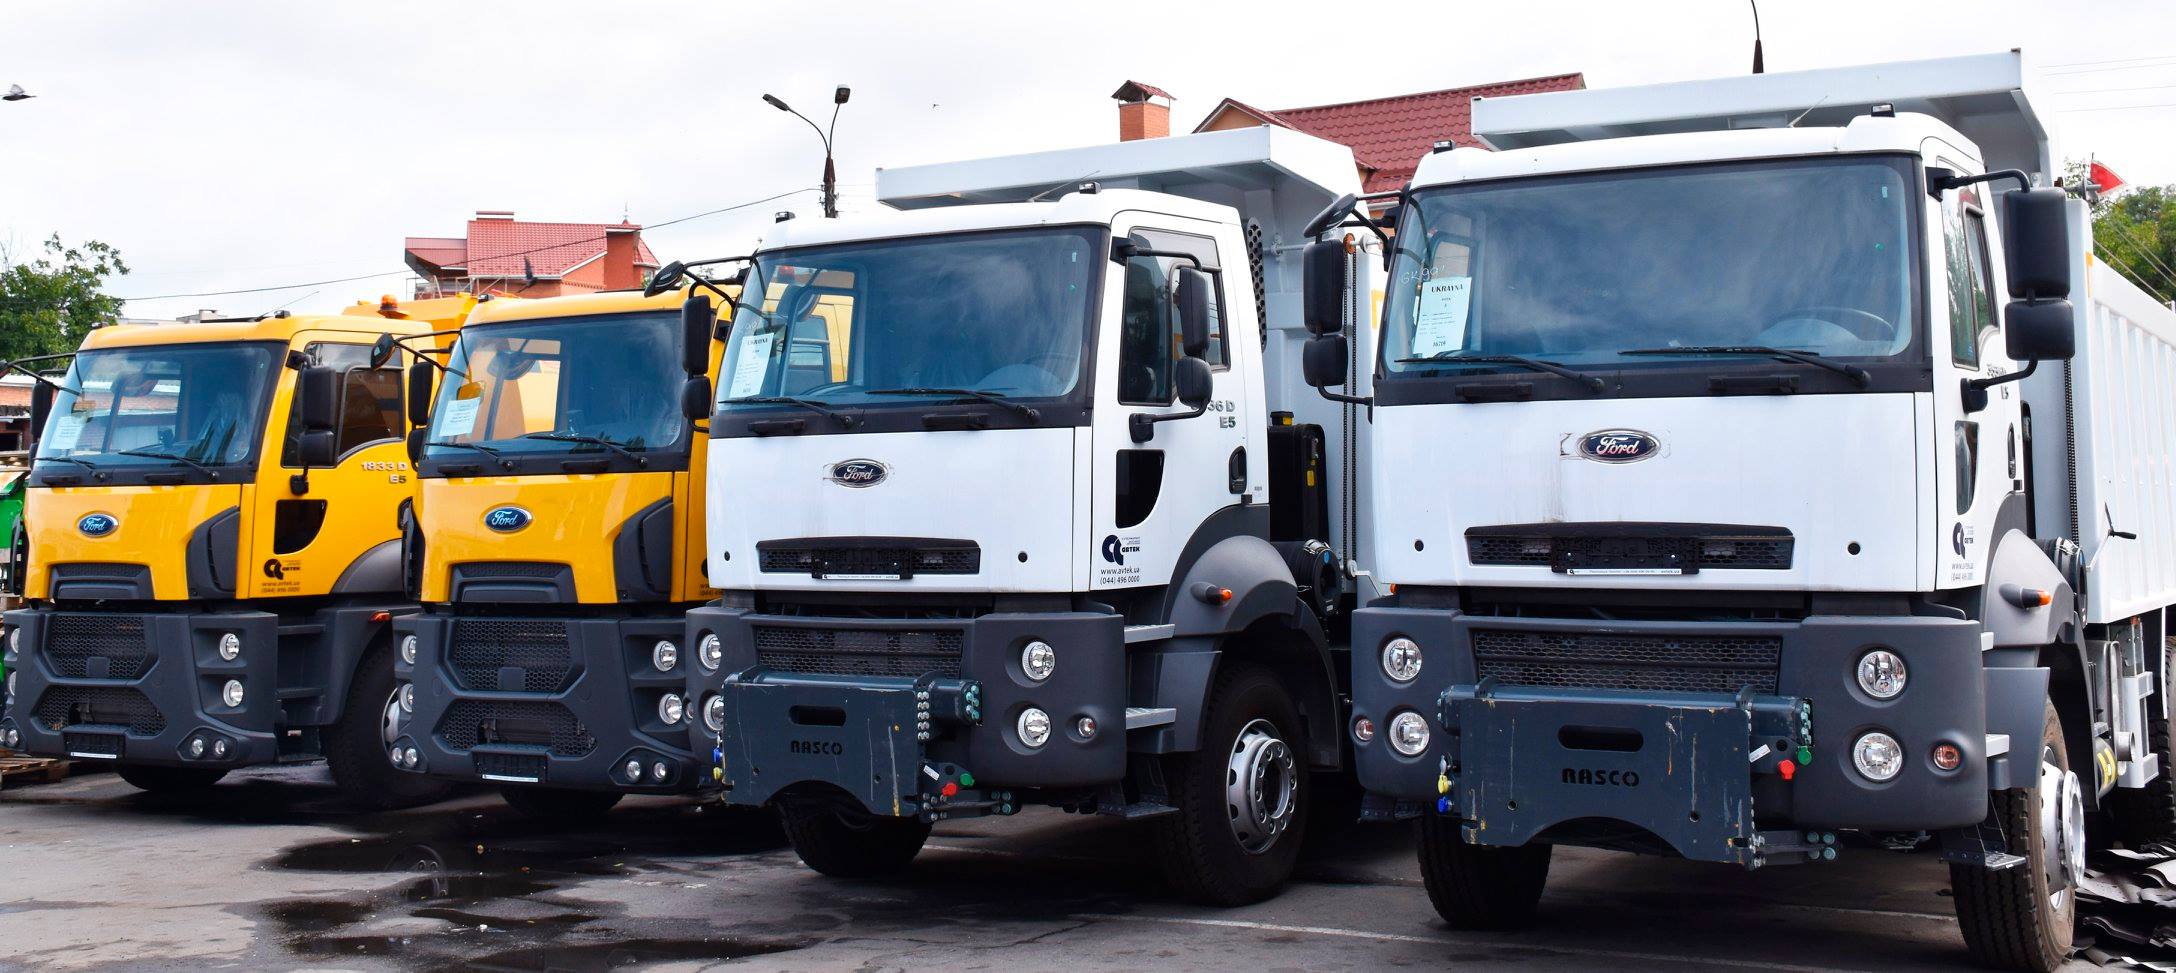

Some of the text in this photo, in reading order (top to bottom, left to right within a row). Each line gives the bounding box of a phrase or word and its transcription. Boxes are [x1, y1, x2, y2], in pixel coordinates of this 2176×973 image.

[1225, 399, 1236, 412] D
[1219, 415, 1237, 429] E5
[1596, 436, 1640, 455] Ford
[361, 461, 408, 472] 1833 D
[843, 465, 874, 480] Ford
[389, 474, 407, 484] E5
[83, 517, 107, 531] Ford
[491, 510, 519, 526] Ford
[1100, 566, 1140, 576] www.avtek.ua
[1100, 576, 1116, 585] (044)
[790, 740, 843, 756] RASCO
[1561, 768, 1640, 788] RASCO
